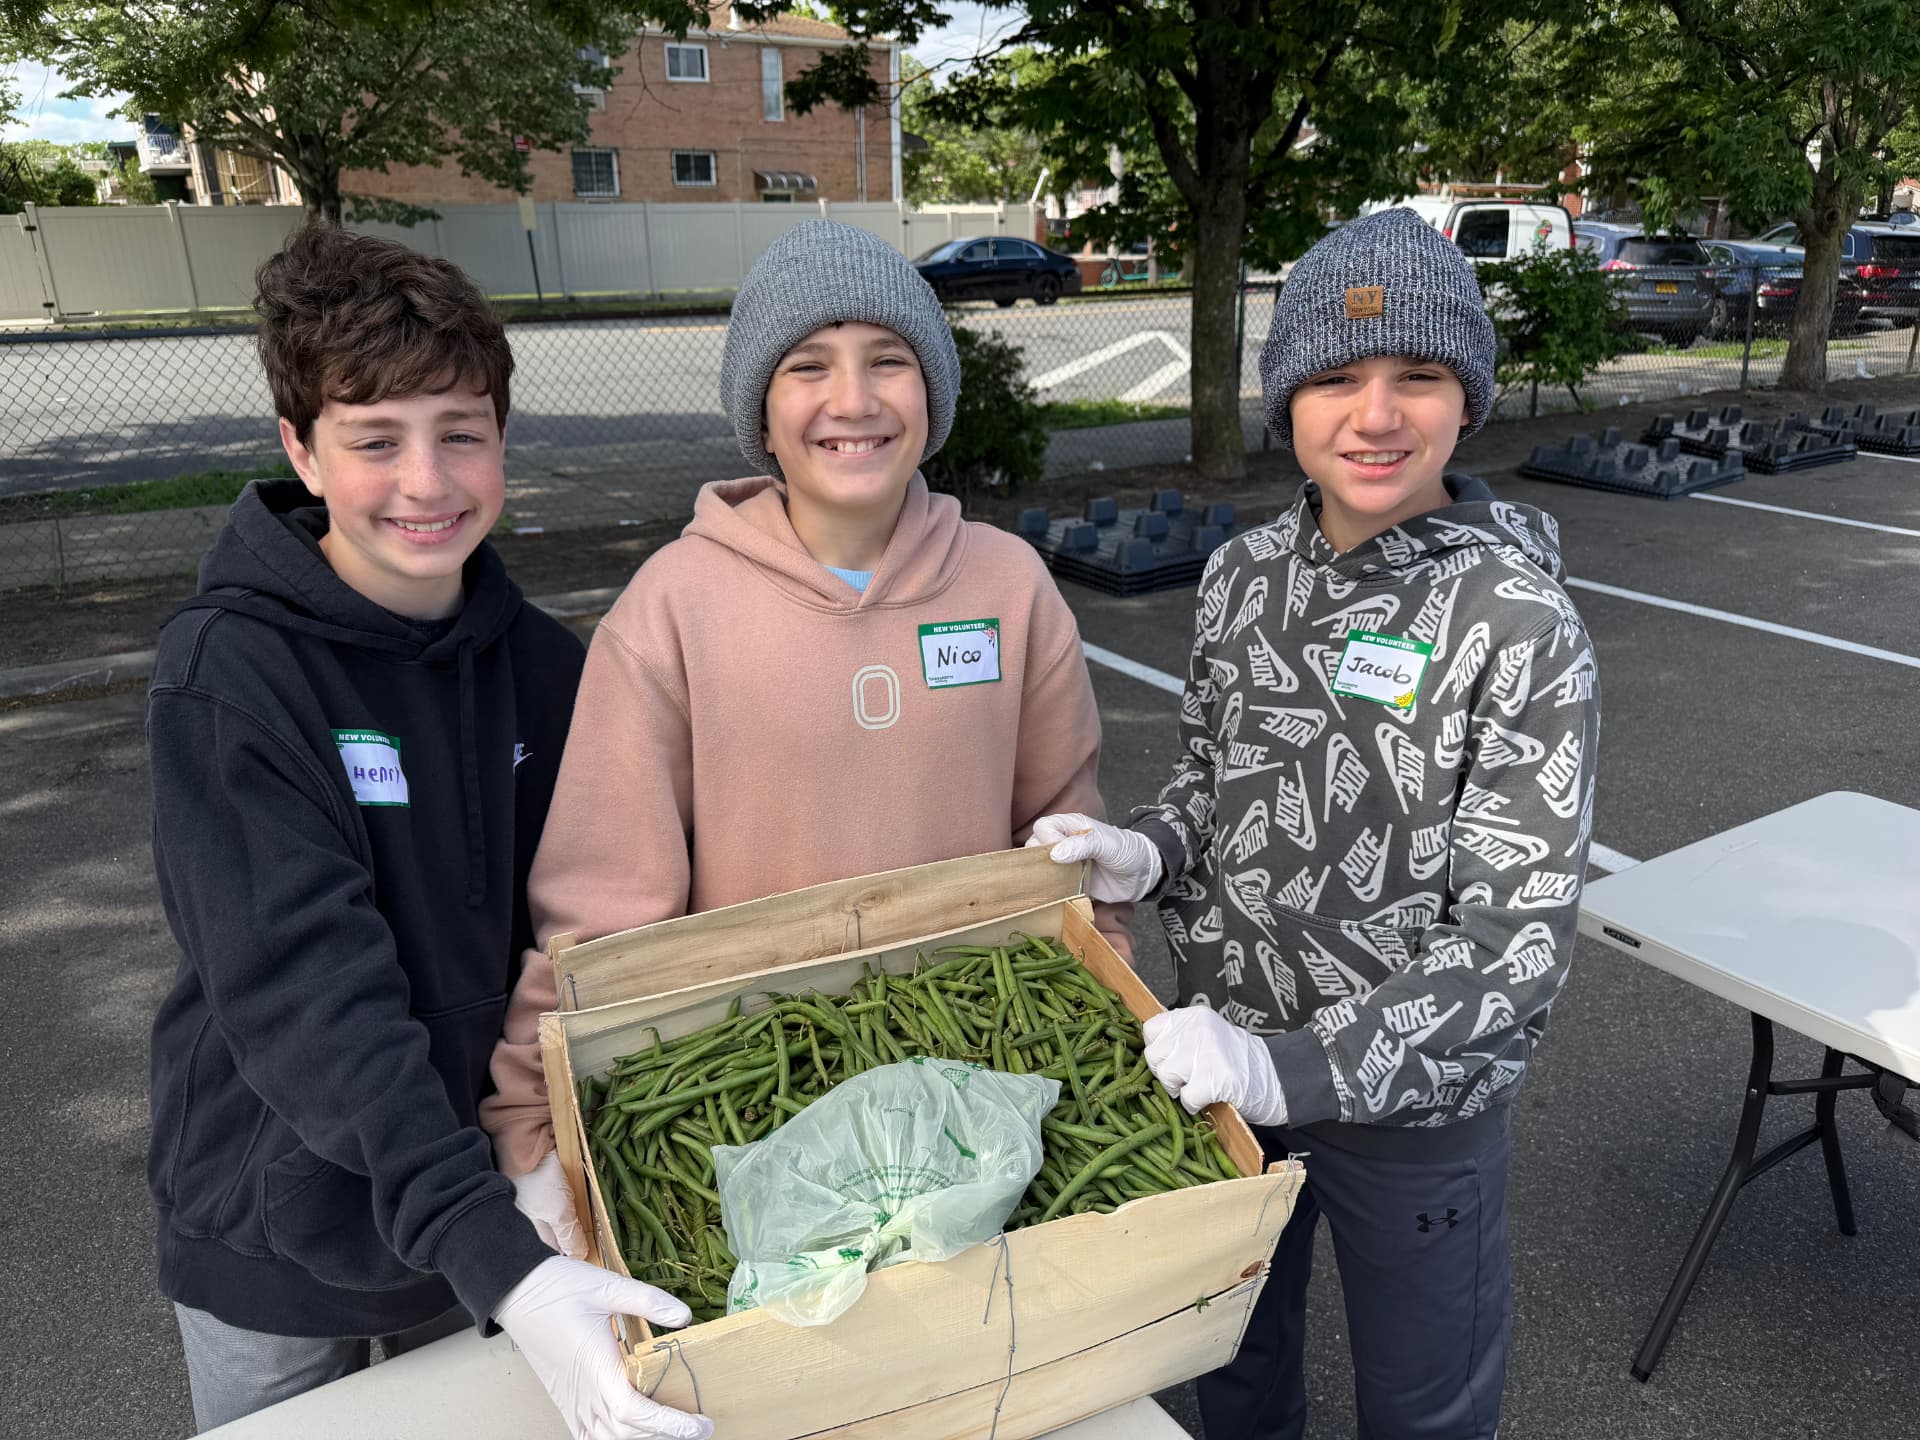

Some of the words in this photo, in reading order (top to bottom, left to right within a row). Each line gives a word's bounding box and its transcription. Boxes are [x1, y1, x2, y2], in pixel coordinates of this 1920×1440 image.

[1351, 290, 1378, 305] NY
[1242, 532, 1278, 562] NIKE
[1428, 544, 1482, 586] NIKE
[1291, 562, 1316, 618] NIKE
[1233, 592, 1264, 640] NIKE
[1408, 587, 1446, 644] NIKE
[937, 645, 982, 669] Nico
[1376, 637, 1416, 650] VOLUNTEER
[1246, 645, 1278, 687] NIKE
[1346, 656, 1412, 685] Jacob
[1453, 640, 1486, 703] NIKE
[1554, 670, 1593, 708] NIKE
[338, 733, 359, 741] NEW
[1258, 712, 1317, 749] NIKE
[1227, 741, 1269, 769] NIKE
[1397, 738, 1425, 802] NIKE
[1535, 730, 1580, 798] NIKE
[1334, 752, 1370, 814] NIKE
[1275, 776, 1302, 836] NIKE
[1235, 820, 1269, 865] NIKE
[1338, 827, 1383, 884] NIKE
[1411, 818, 1449, 860] NIK
[1454, 831, 1527, 872] NIKE
[1522, 871, 1579, 898] NIK
[1159, 907, 1190, 943] NIKE
[1298, 950, 1351, 996] NIKE
[1422, 942, 1474, 976] NIKE
[1508, 942, 1556, 985] NIKE
[1272, 955, 1299, 1010] NIKE
[1382, 993, 1438, 1034] NIKE
[1356, 1029, 1397, 1095] NIKE
